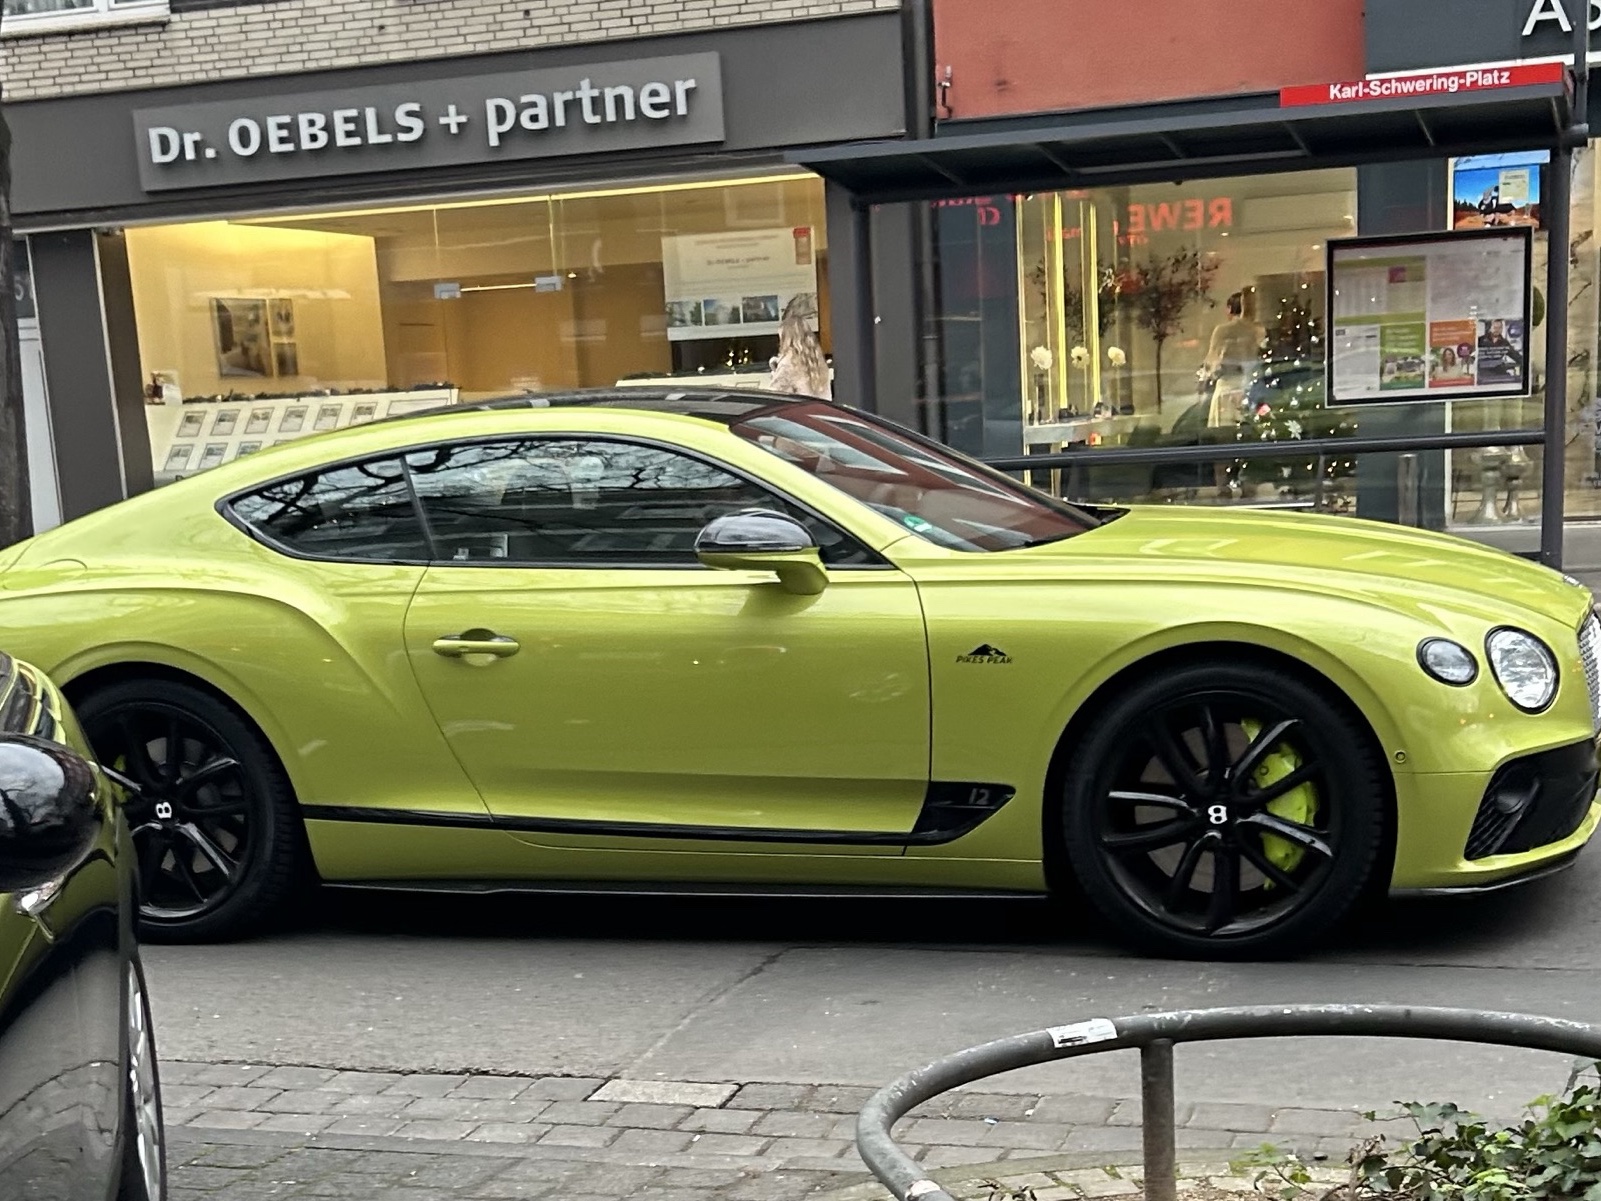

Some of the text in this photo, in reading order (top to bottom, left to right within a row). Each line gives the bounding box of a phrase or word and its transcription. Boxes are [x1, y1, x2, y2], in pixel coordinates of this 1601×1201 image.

[1329, 70, 1511, 100] Karl-Schwering-Platz
[149, 78, 697, 163] Dr. OEBELS + partner
[955, 655, 1013, 664] PIKES PEAK
[969, 788, 990, 805] 12
